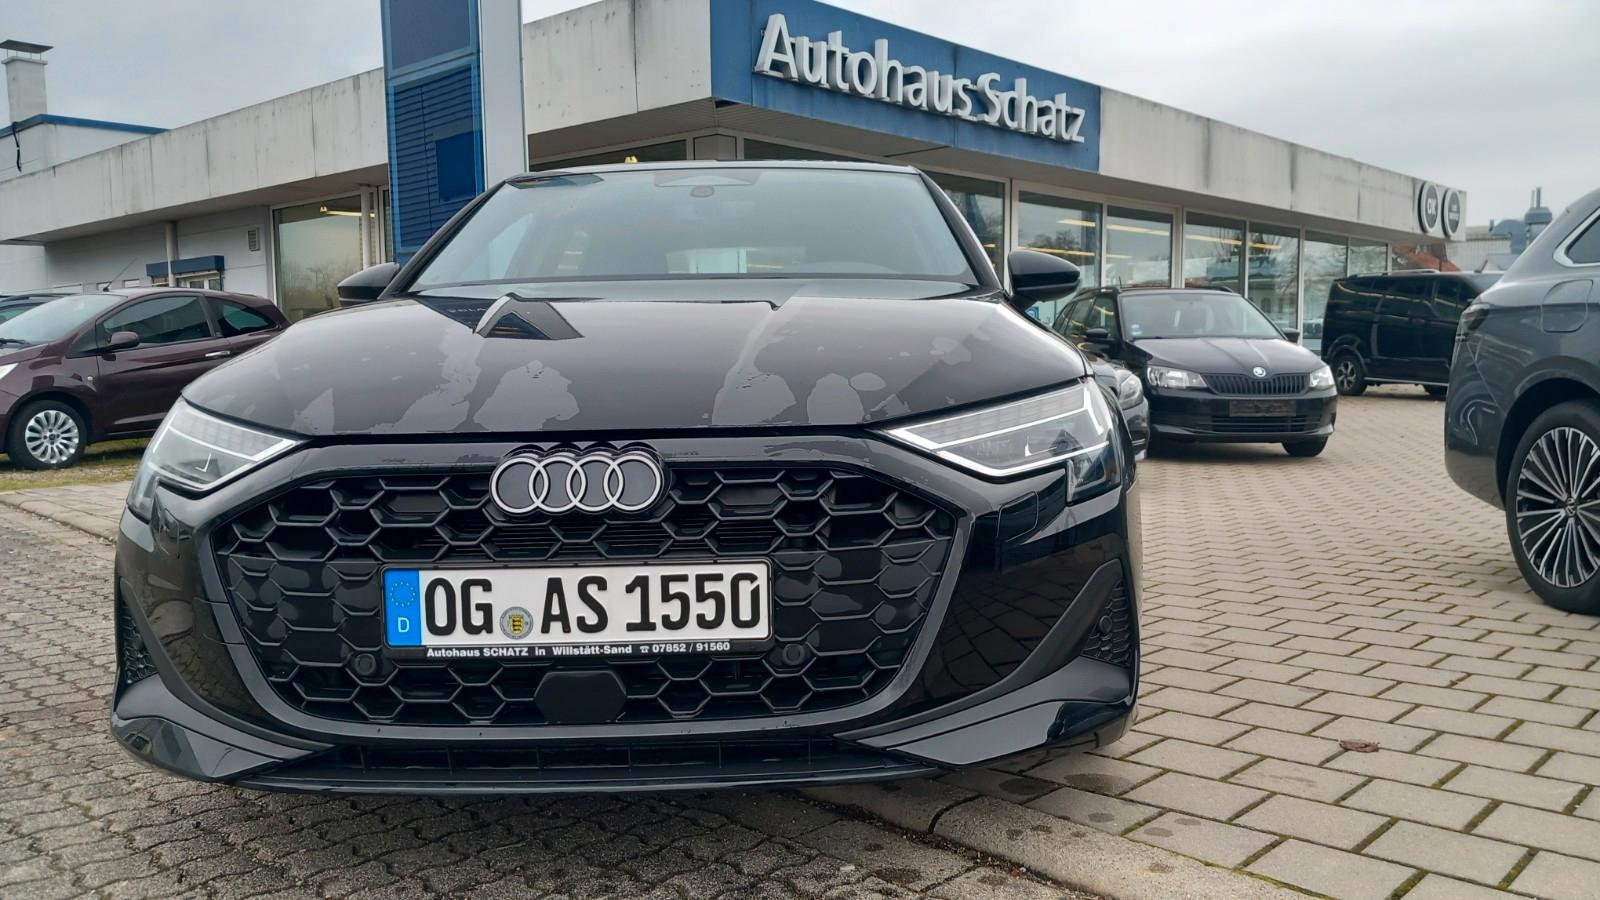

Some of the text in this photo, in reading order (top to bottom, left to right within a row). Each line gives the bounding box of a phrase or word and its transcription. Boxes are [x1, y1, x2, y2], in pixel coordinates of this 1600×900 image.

[753, 13, 1086, 143] Autohaus Schatz
[424, 577, 494, 636] OG
[541, 576, 608, 635] AS
[625, 573, 761, 632] 1550
[397, 617, 410, 633] D
[426, 648, 480, 657] Autohaus
[483, 647, 529, 657] SCHATZ
[535, 646, 546, 656] in
[552, 644, 632, 656] Willstätt-Sand
[652, 643, 686, 653] 07852
[696, 642, 730, 651] 91560
